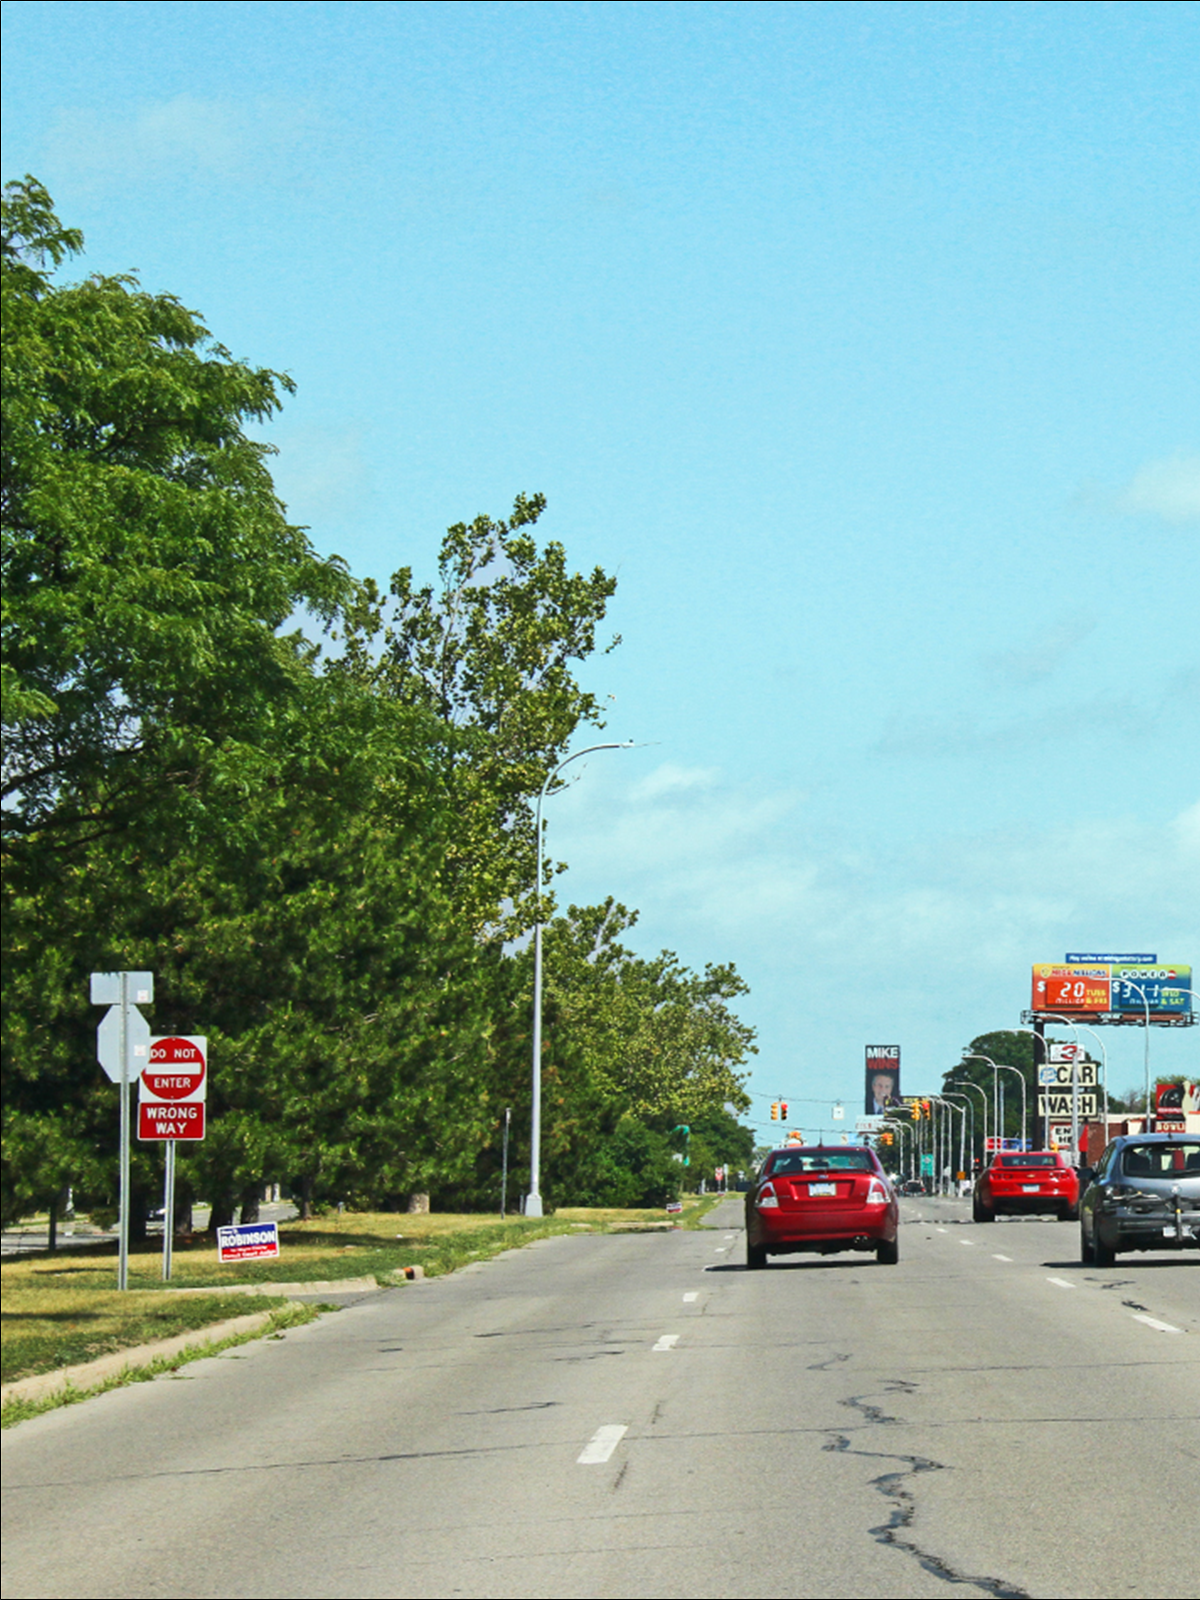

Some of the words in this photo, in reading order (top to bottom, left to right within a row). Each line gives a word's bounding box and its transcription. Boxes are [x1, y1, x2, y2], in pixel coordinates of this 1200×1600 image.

[1060, 982, 1085, 998] 20
[150, 1048, 167, 1059] DO
[174, 1048, 196, 1058] NOT
[867, 1046, 899, 1058] MIKE
[867, 1059, 899, 1069] WINS
[154, 1077, 191, 1088] ENTER
[1040, 1096, 1093, 1113] WASH
[146, 1107, 198, 1119] WRONG
[156, 1122, 187, 1134] WAY
[221, 1231, 276, 1248] ROBINSON
